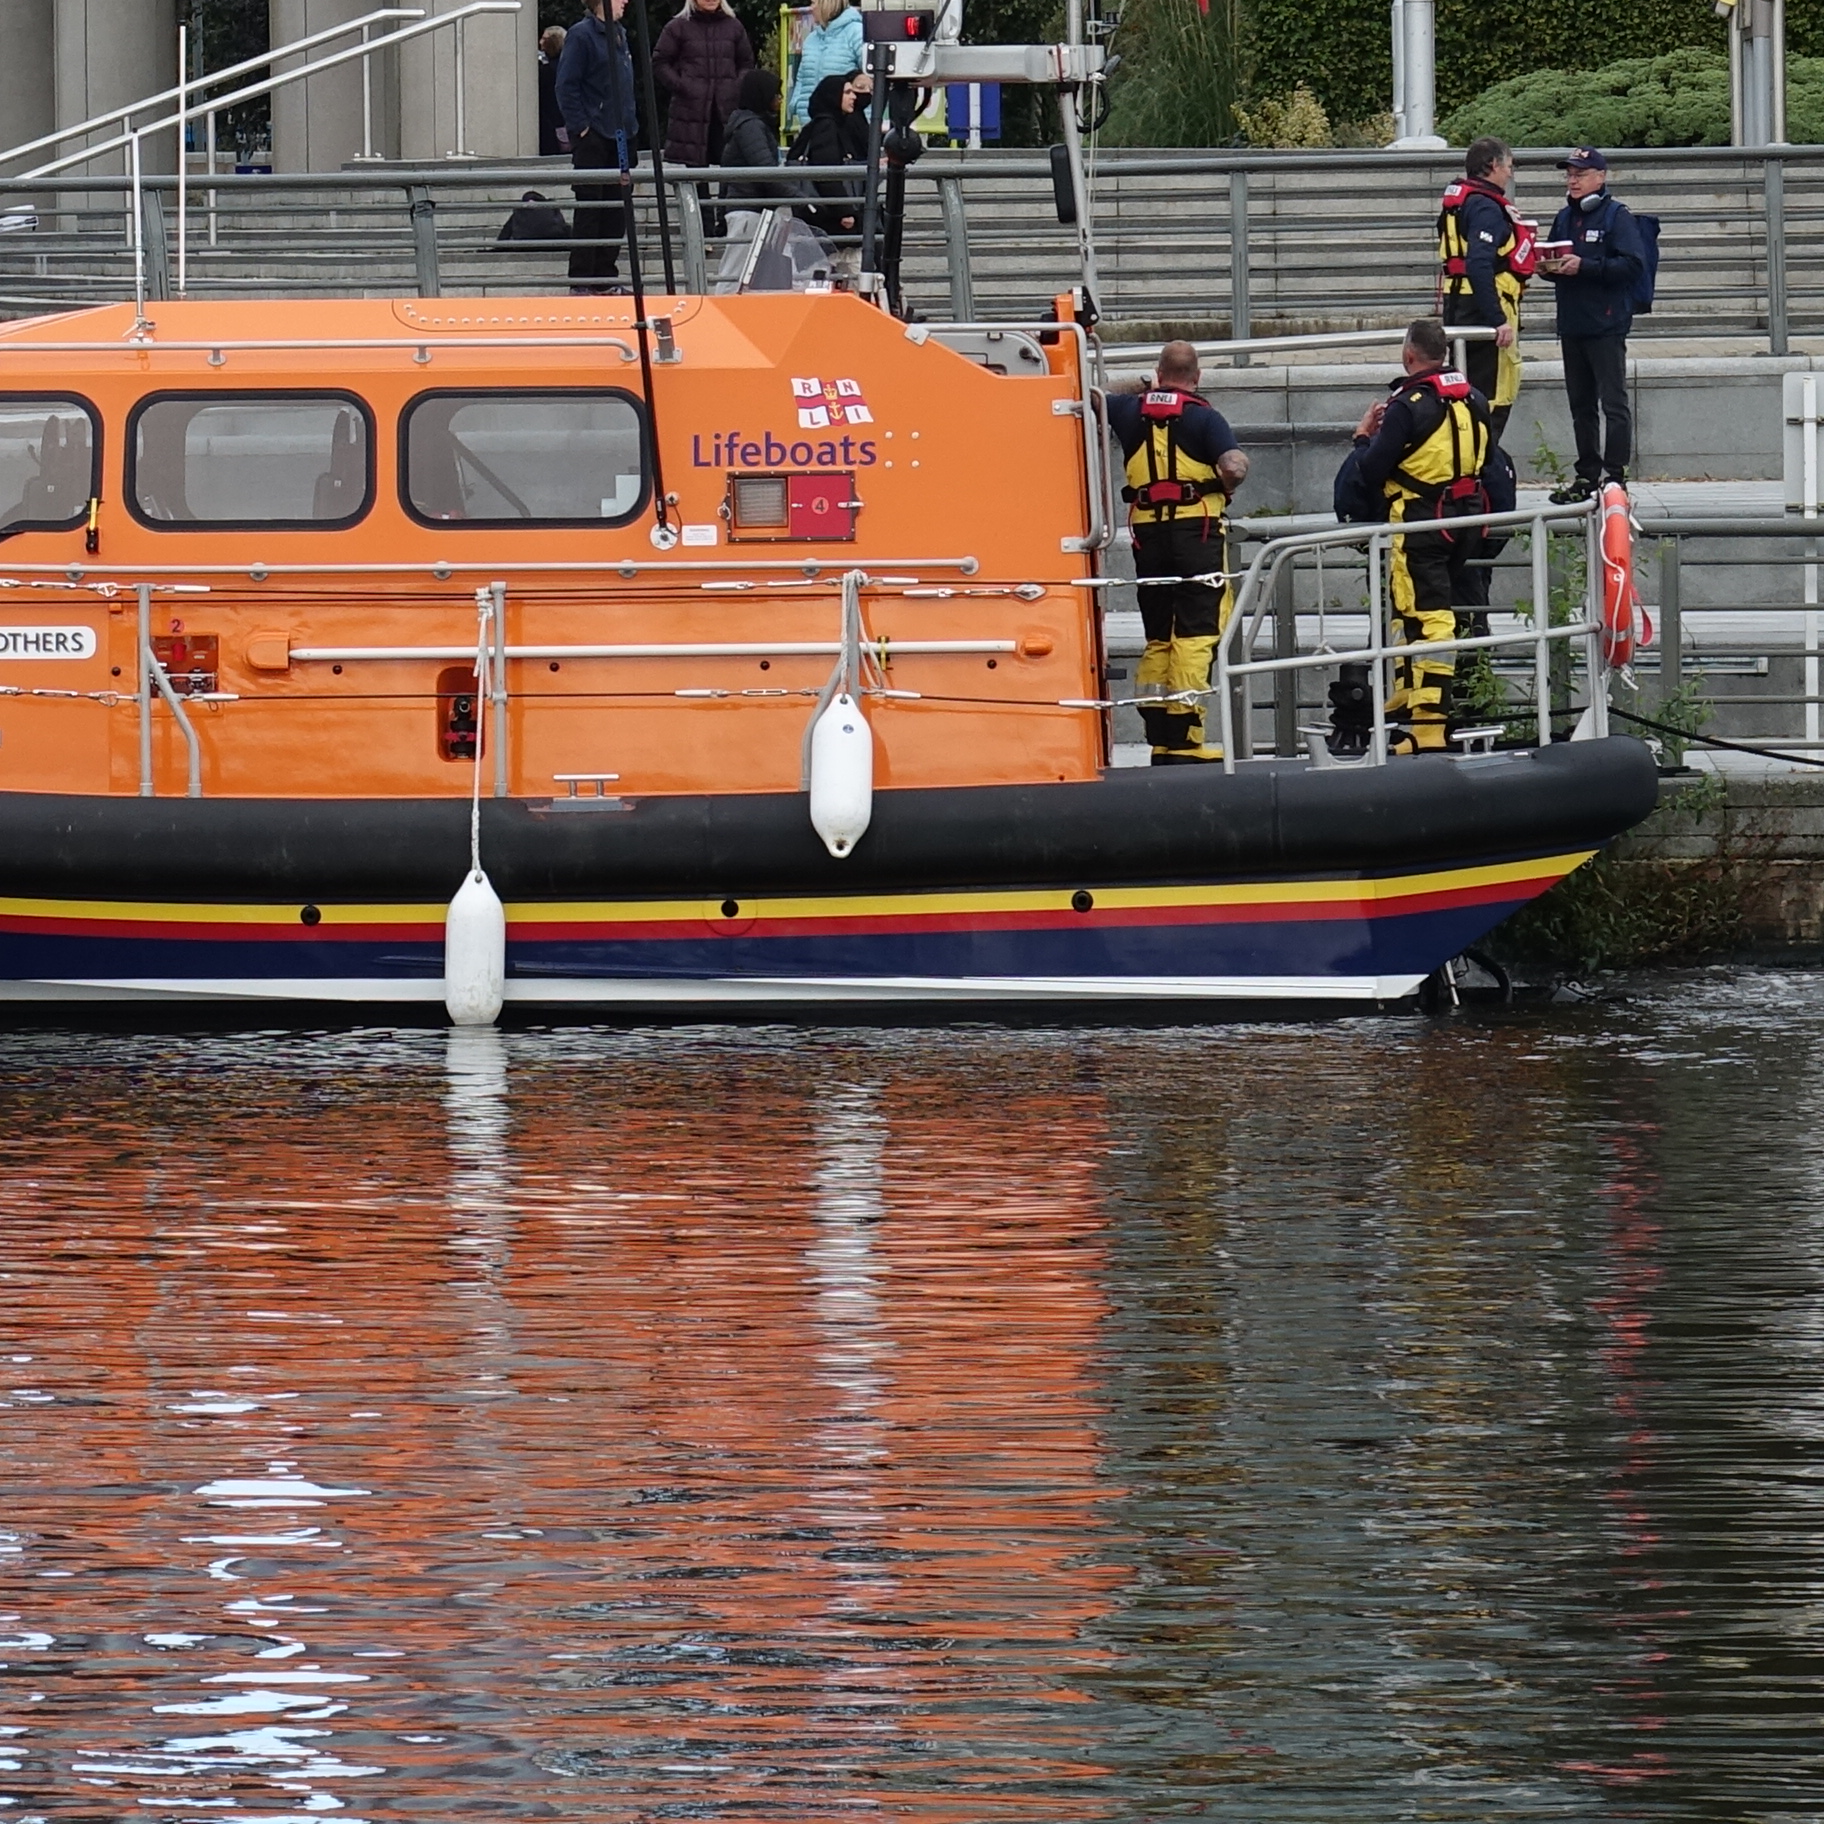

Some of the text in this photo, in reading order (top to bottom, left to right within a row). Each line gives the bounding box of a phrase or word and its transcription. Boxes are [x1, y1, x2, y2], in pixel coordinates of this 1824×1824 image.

[1444, 373, 1464, 384] RNLI
[1149, 393, 1173, 404] RNLI
[693, 431, 877, 467] Lifeboats
[815, 498, 825, 512] 4
[172, 620, 181, 632] 2
